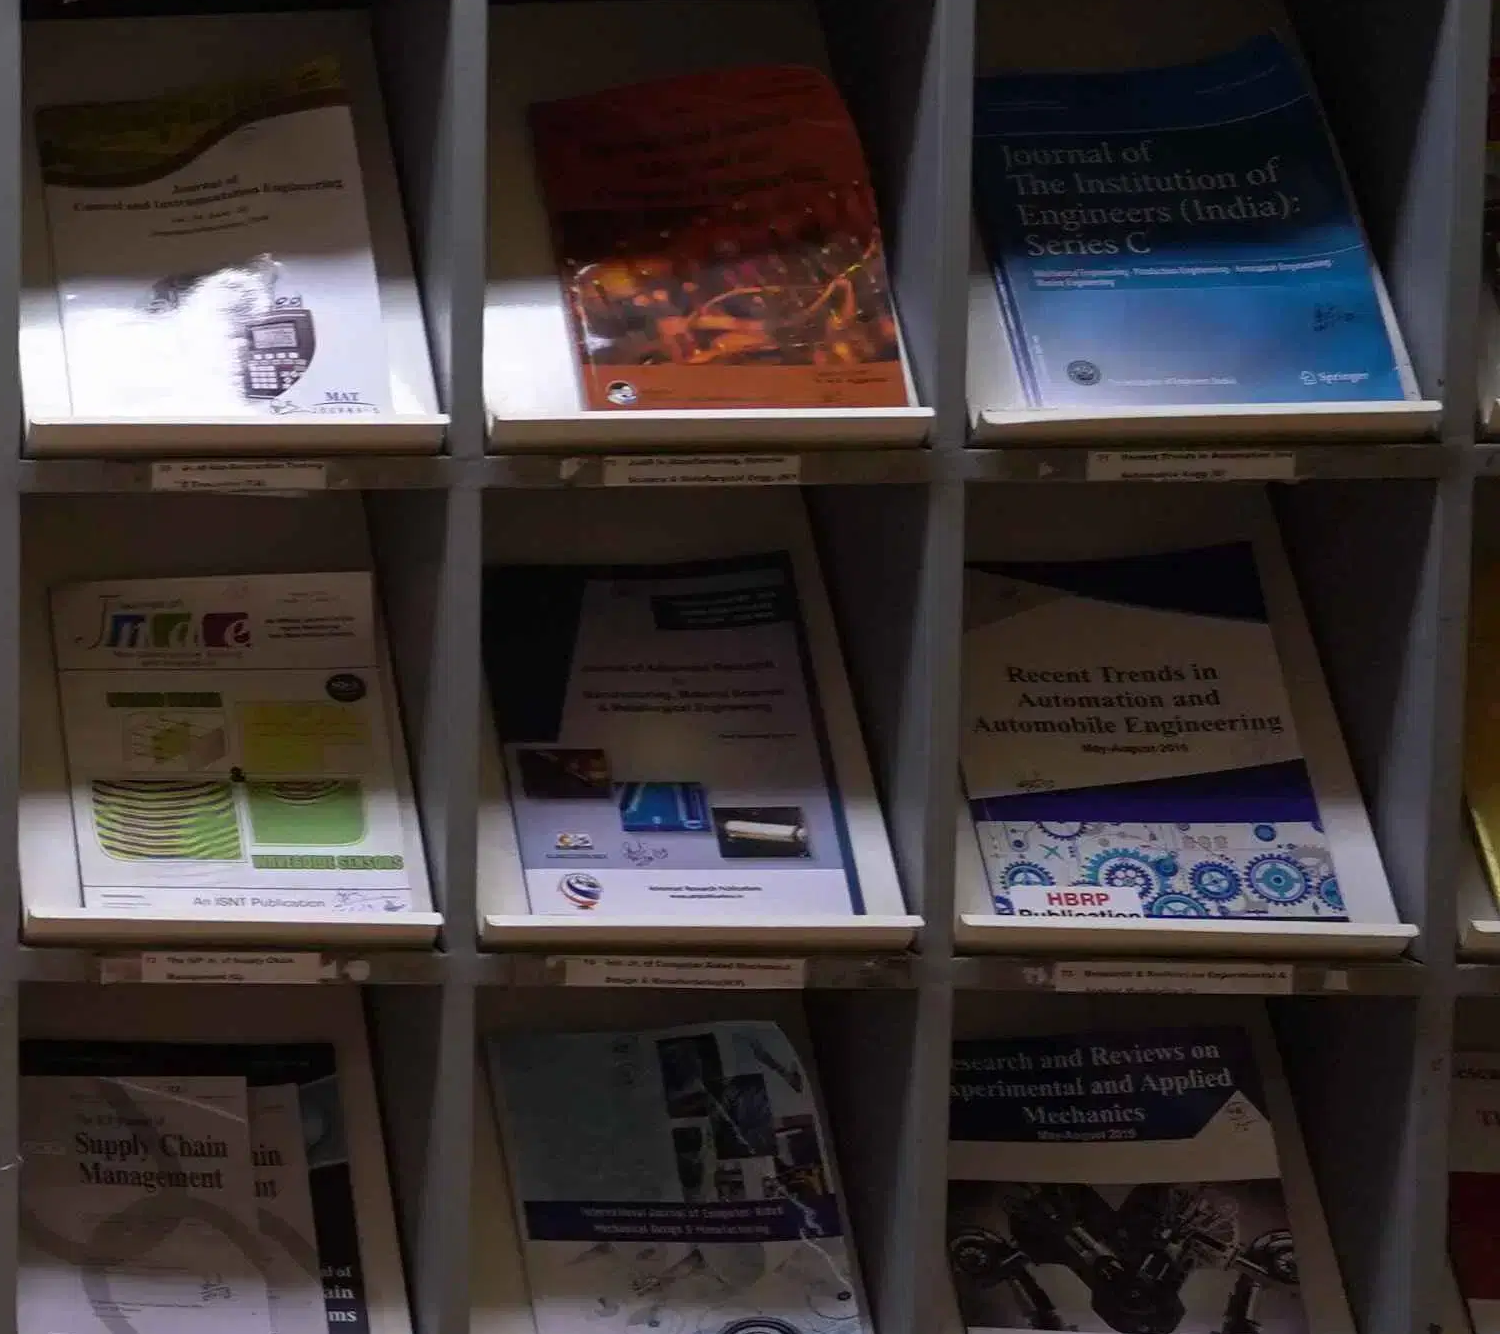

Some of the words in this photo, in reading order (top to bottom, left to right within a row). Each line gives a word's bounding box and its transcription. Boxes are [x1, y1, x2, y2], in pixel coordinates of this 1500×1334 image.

[1000, 141, 1114, 172] Journal
[1121, 139, 1155, 164] of
[1005, 172, 1068, 196] The
[1075, 166, 1237, 195] Institution
[1245, 155, 1285, 187] of
[1019, 201, 1173, 232] Engineers
[1178, 195, 1301, 226] (India):
[1027, 233, 1120, 258] Series
[1126, 231, 1152, 255] C
[1318, 370, 1370, 383] Springer
[324, 391, 360, 404] MAT
[1006, 665, 1091, 685] Recent
[1096, 664, 1186, 684] Trends
[1191, 662, 1220, 681] in
[1017, 691, 1165, 710] Automation
[1170, 688, 1221, 708] and
[972, 714, 1117, 736] Automobile
[1124, 713, 1285, 737] Engineering
[192, 895, 212, 908] An
[214, 896, 247, 908] ISNT
[250, 896, 326, 910] Publication
[1046, 891, 1111, 907] HBRP
[1019, 1105, 1148, 1126] Mechanics
[74, 1131, 150, 1161] Supply
[158, 1131, 230, 1160] Chain
[78, 1161, 225, 1192] Management
